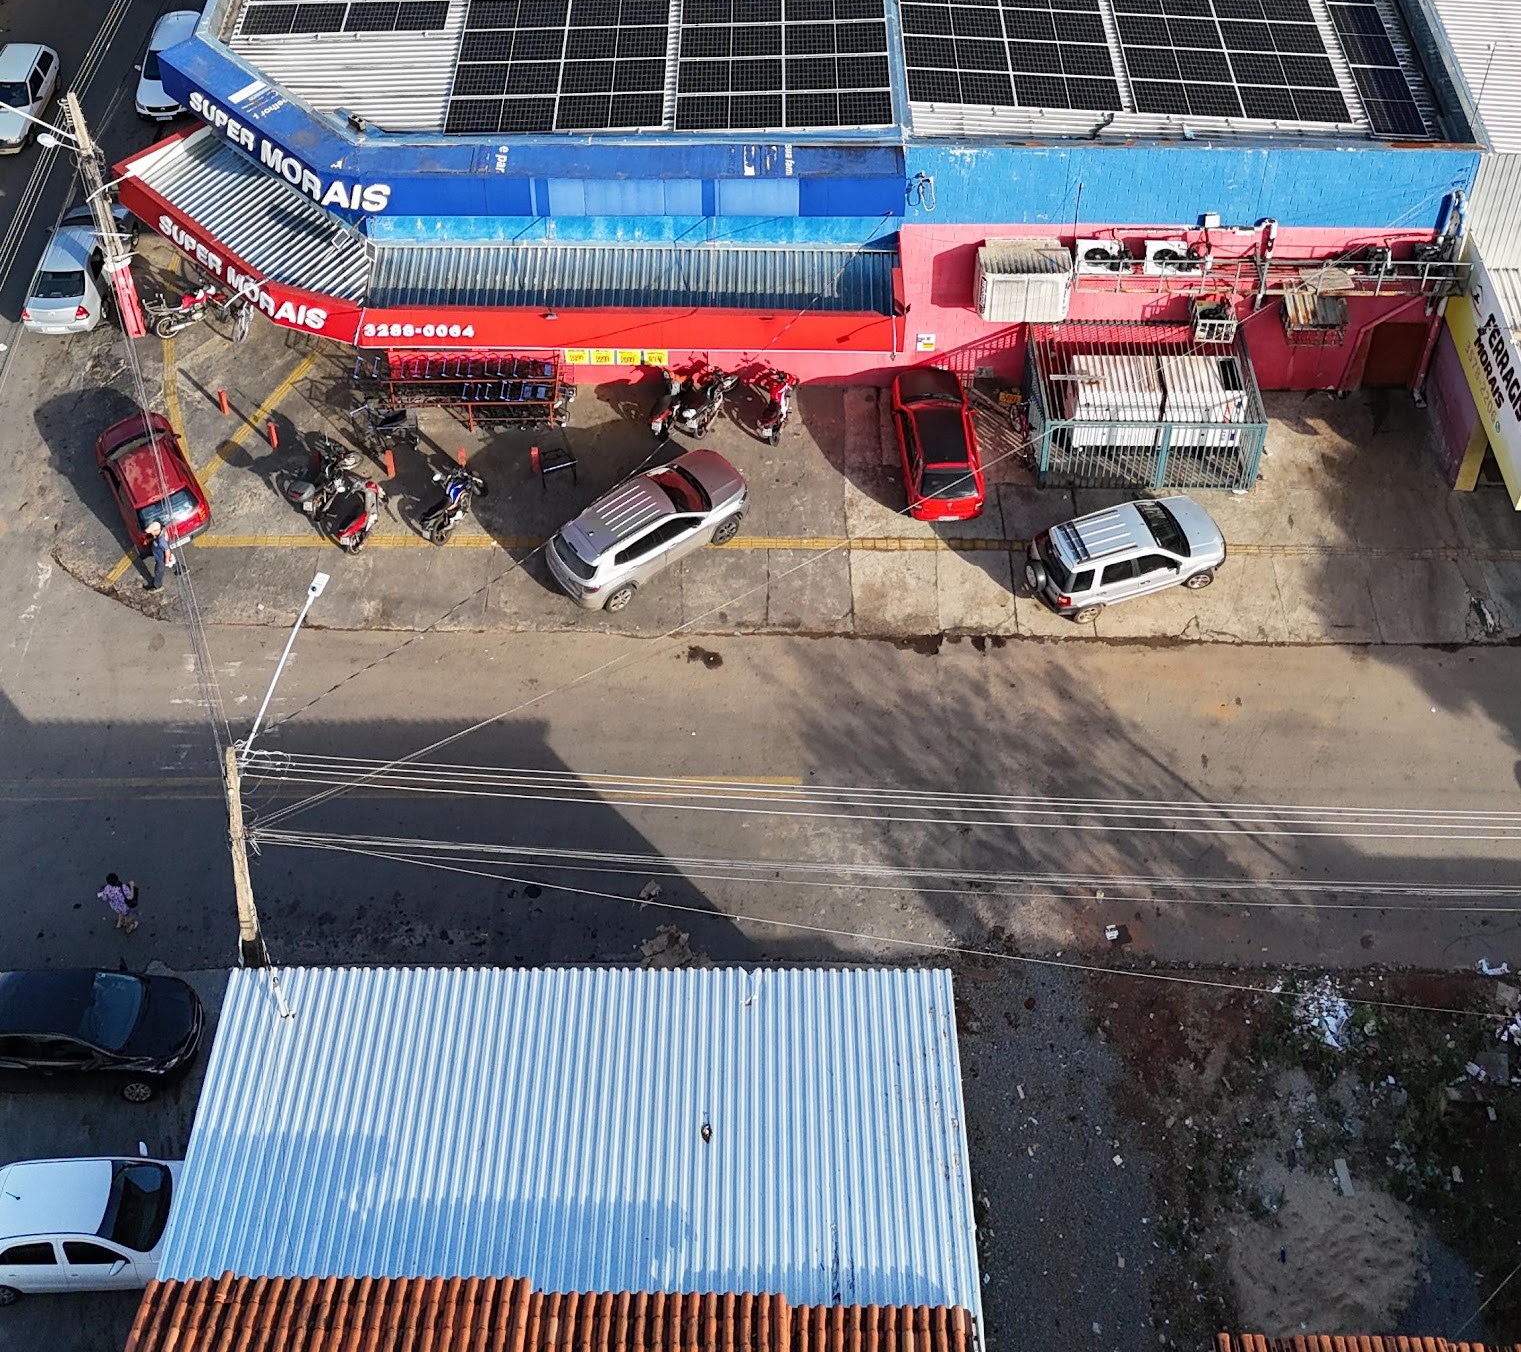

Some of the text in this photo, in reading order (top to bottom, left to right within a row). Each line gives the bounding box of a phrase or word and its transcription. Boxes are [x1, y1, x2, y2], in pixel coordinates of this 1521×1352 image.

[189, 92, 391, 212] SUPER MORAIS
[158, 215, 328, 329] SUPER MORAIS
[1474, 334, 1505, 409] MORAIS
